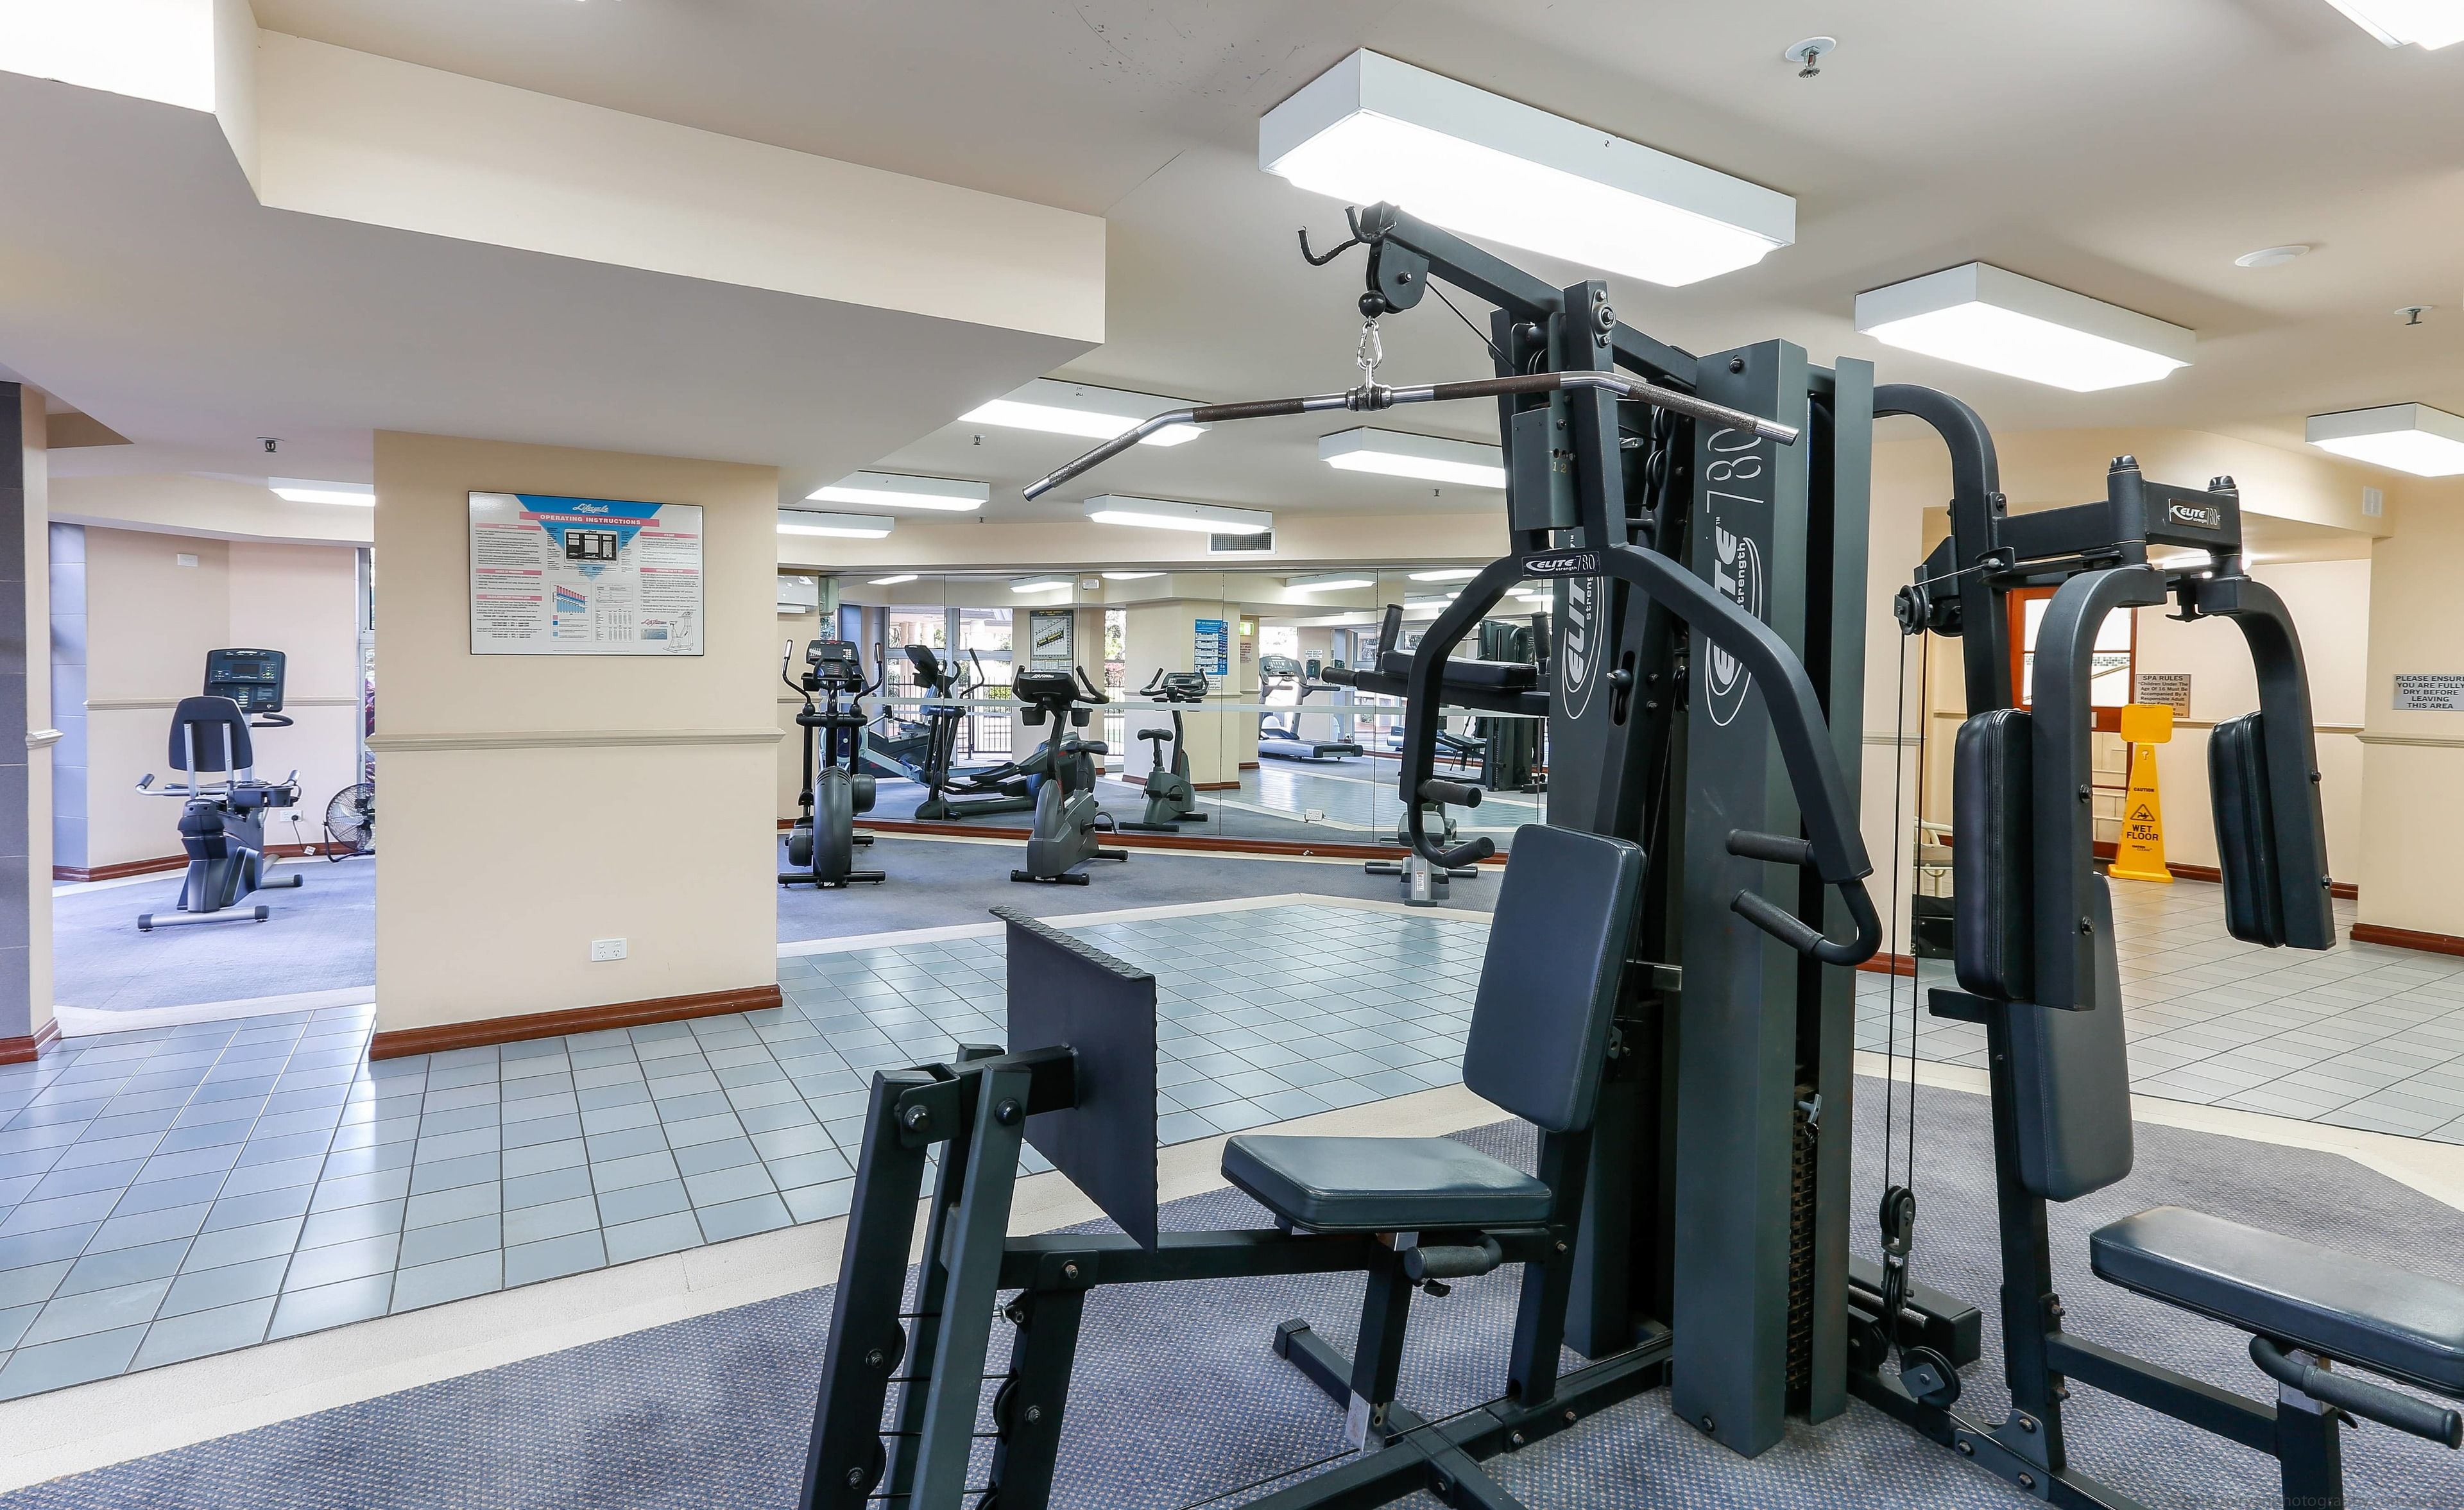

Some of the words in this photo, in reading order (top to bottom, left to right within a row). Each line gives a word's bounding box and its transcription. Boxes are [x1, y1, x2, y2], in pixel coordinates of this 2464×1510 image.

[1707, 428, 1764, 513] 780
[2180, 508, 2206, 519] ELITE
[1537, 559, 1575, 568] ELITE
[1575, 554, 1595, 571] 780
[1737, 542, 1745, 610] trength
[1568, 544, 1585, 683] ELIT
[1714, 526, 1736, 685] ETE
[2126, 832, 2159, 841] FLOOR
